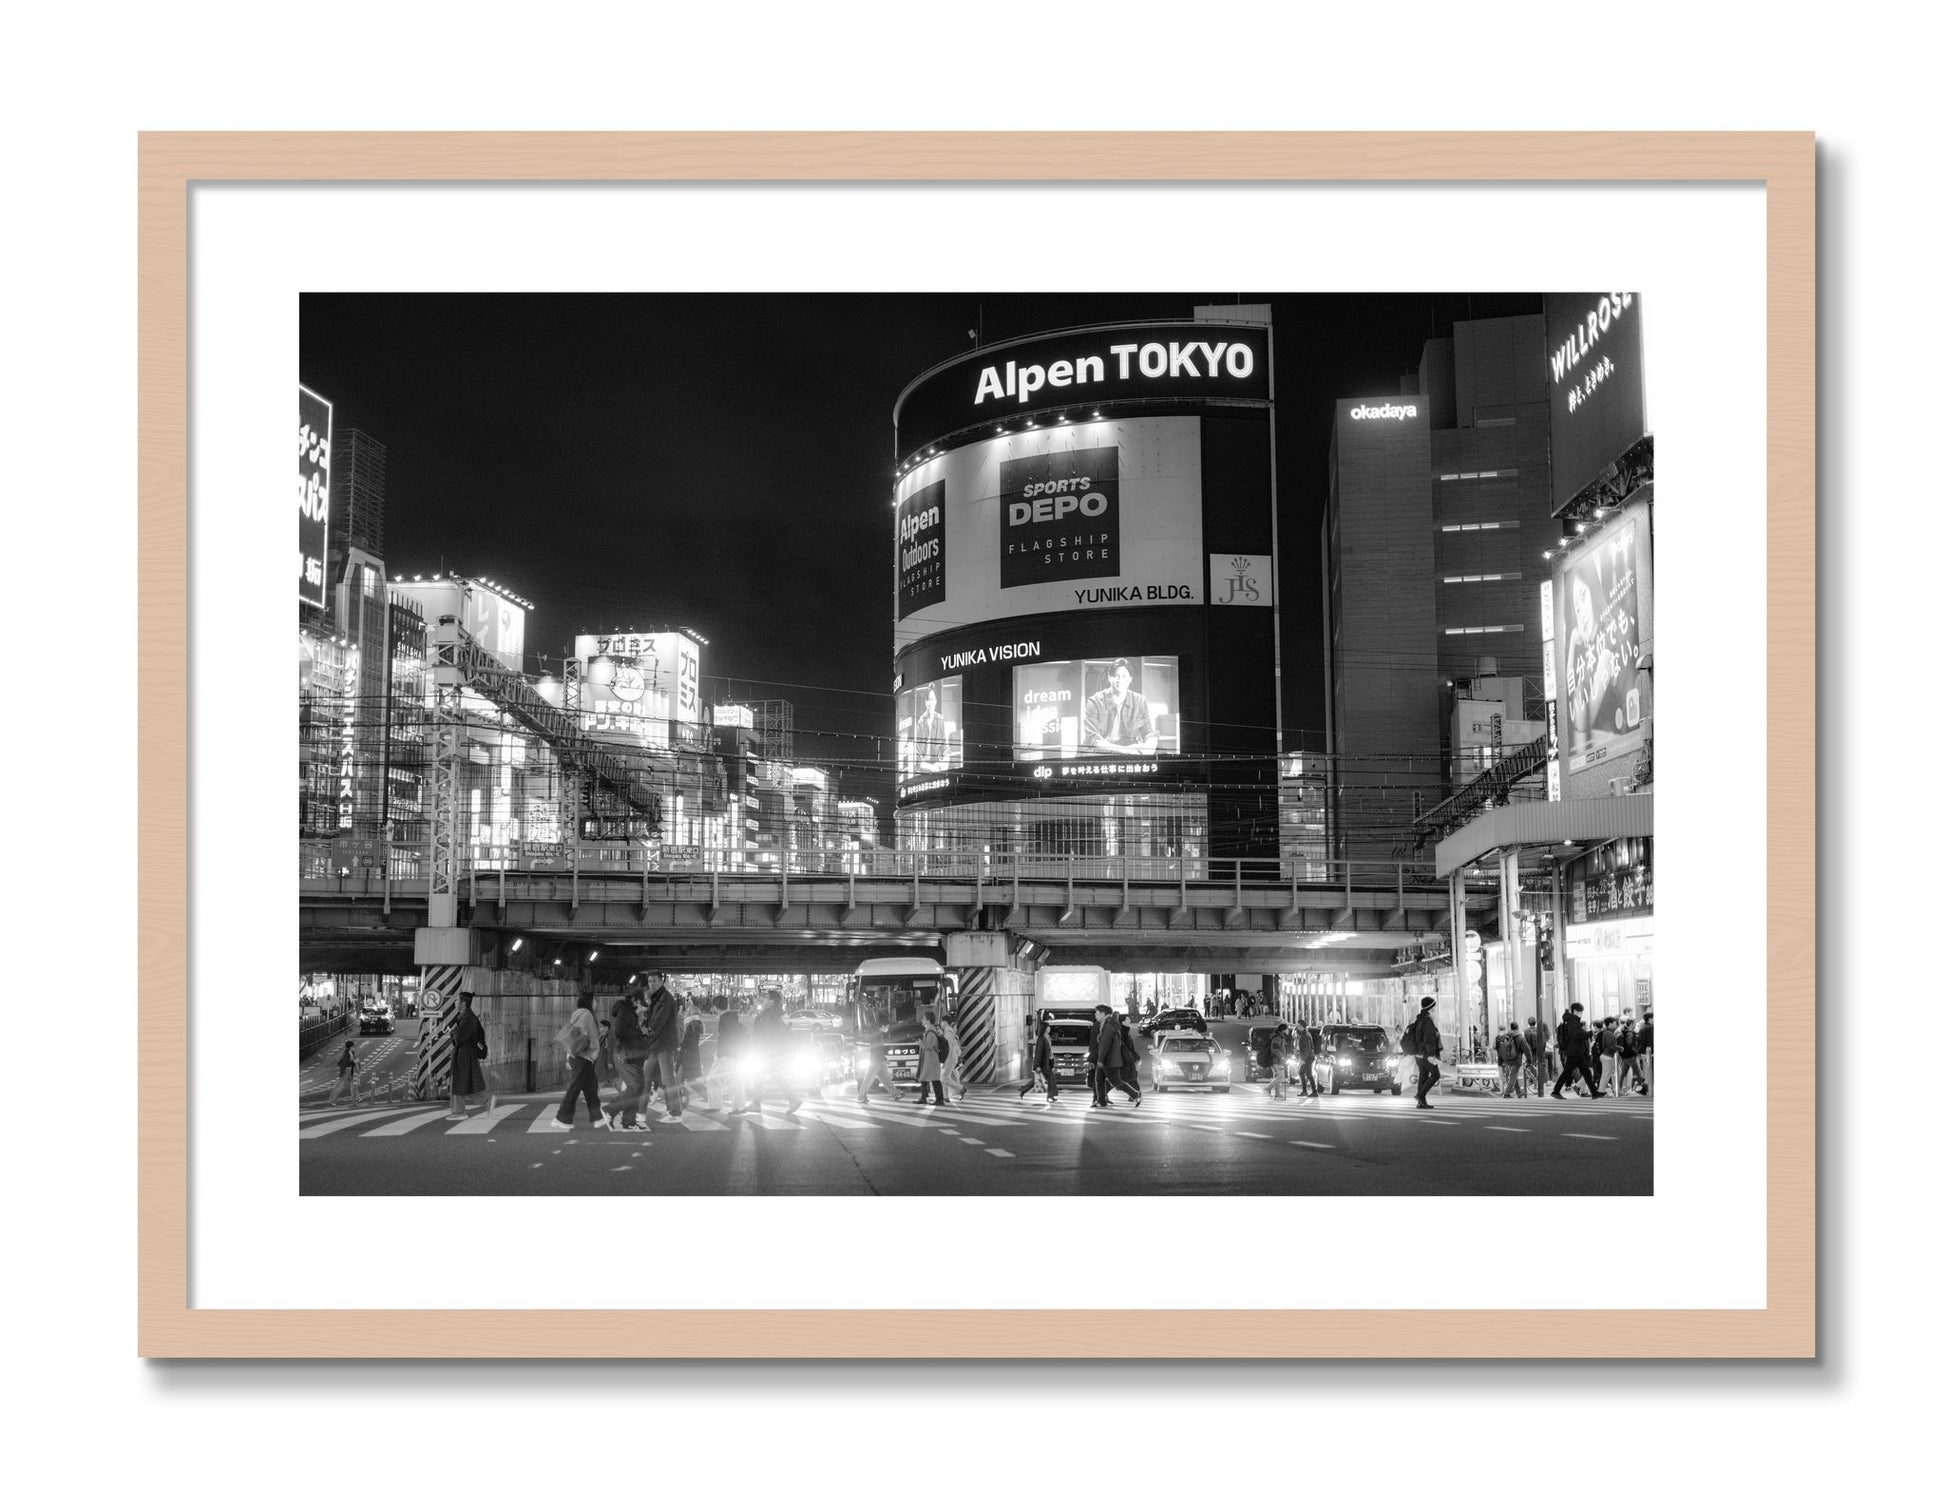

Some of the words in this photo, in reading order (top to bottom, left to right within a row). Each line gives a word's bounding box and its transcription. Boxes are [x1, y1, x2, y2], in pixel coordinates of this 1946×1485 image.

[974, 354, 1104, 404] Alpen
[1110, 342, 1254, 379] TOKYO
[1350, 403, 1417, 420] okadaya
[1023, 476, 1091, 498] SPORTS
[1009, 492, 1107, 527] DEPO
[900, 506, 940, 545] Alpen
[1008, 533, 1109, 555] FLAGSHIP
[902, 538, 940, 572] Outdoors
[1044, 548, 1109, 564] STORE
[910, 576, 940, 597] STORE
[1075, 586, 1142, 603] YUNIKA
[1146, 585, 1195, 600] BLDG.
[397, 641, 423, 659] SHISHA
[597, 637, 656, 654] プロミス
[941, 646, 987, 671] YUNIKA
[989, 641, 1040, 663] VISION
[1024, 689, 1072, 704] dream
[1033, 765, 1052, 779] dip
[1061, 763, 1158, 776] 夢を叶える仕事に出会おう
